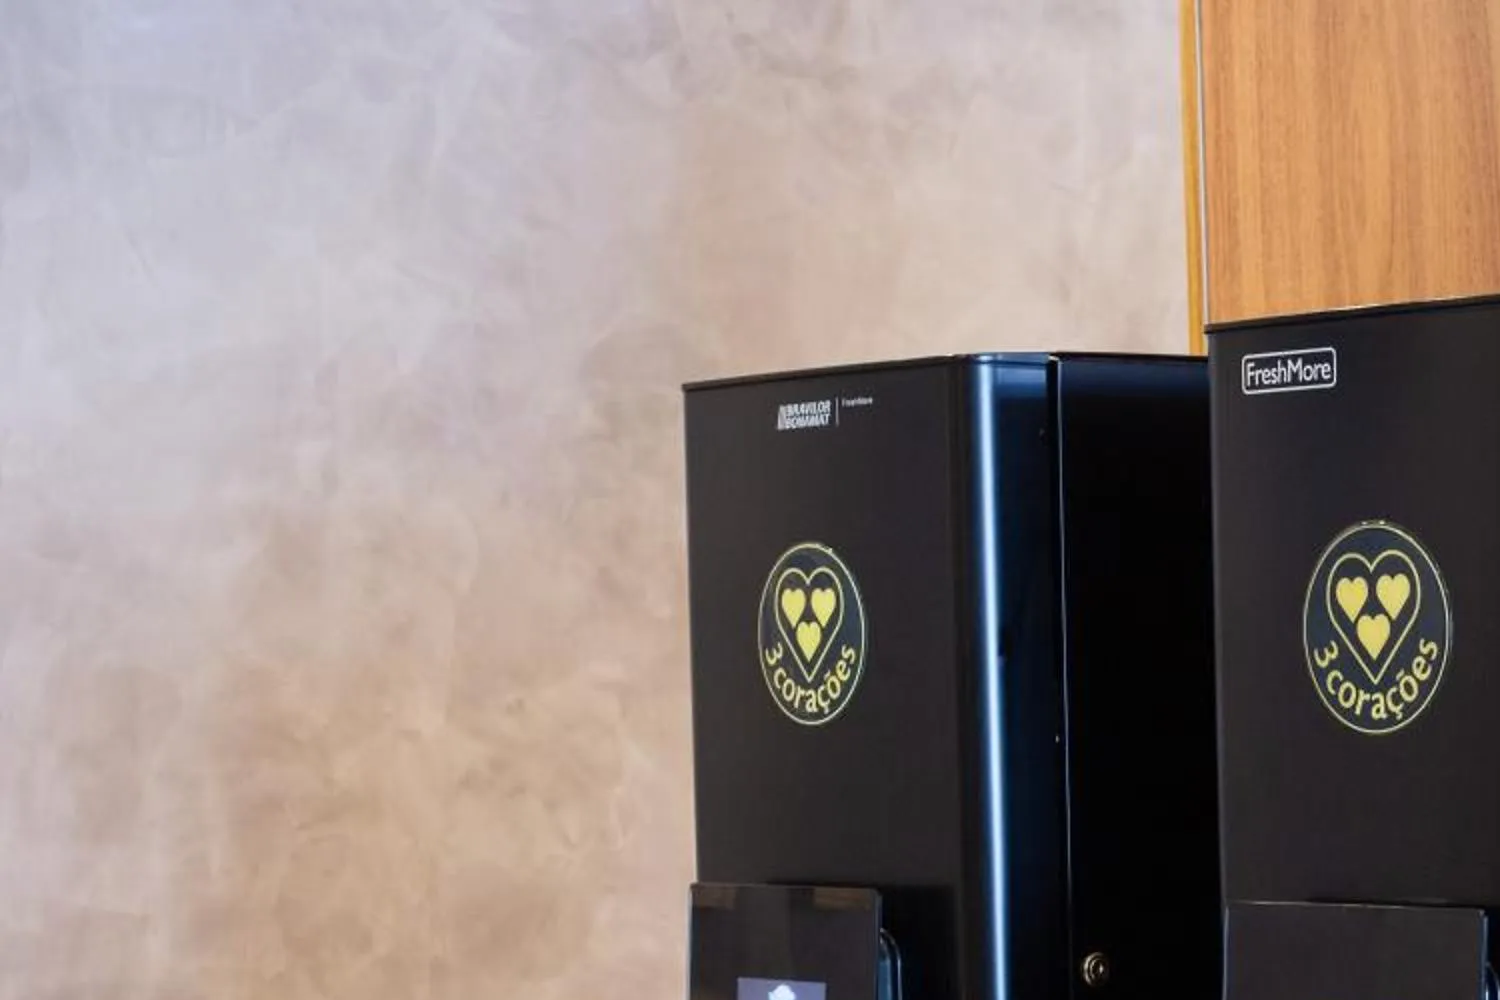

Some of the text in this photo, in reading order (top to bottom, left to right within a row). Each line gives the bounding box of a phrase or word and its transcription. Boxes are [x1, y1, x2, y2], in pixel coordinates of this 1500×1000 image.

[1246, 357, 1332, 387] FreshMore
[766, 642, 856, 714] 3 corações
[1313, 638, 1438, 720] 3 corações
